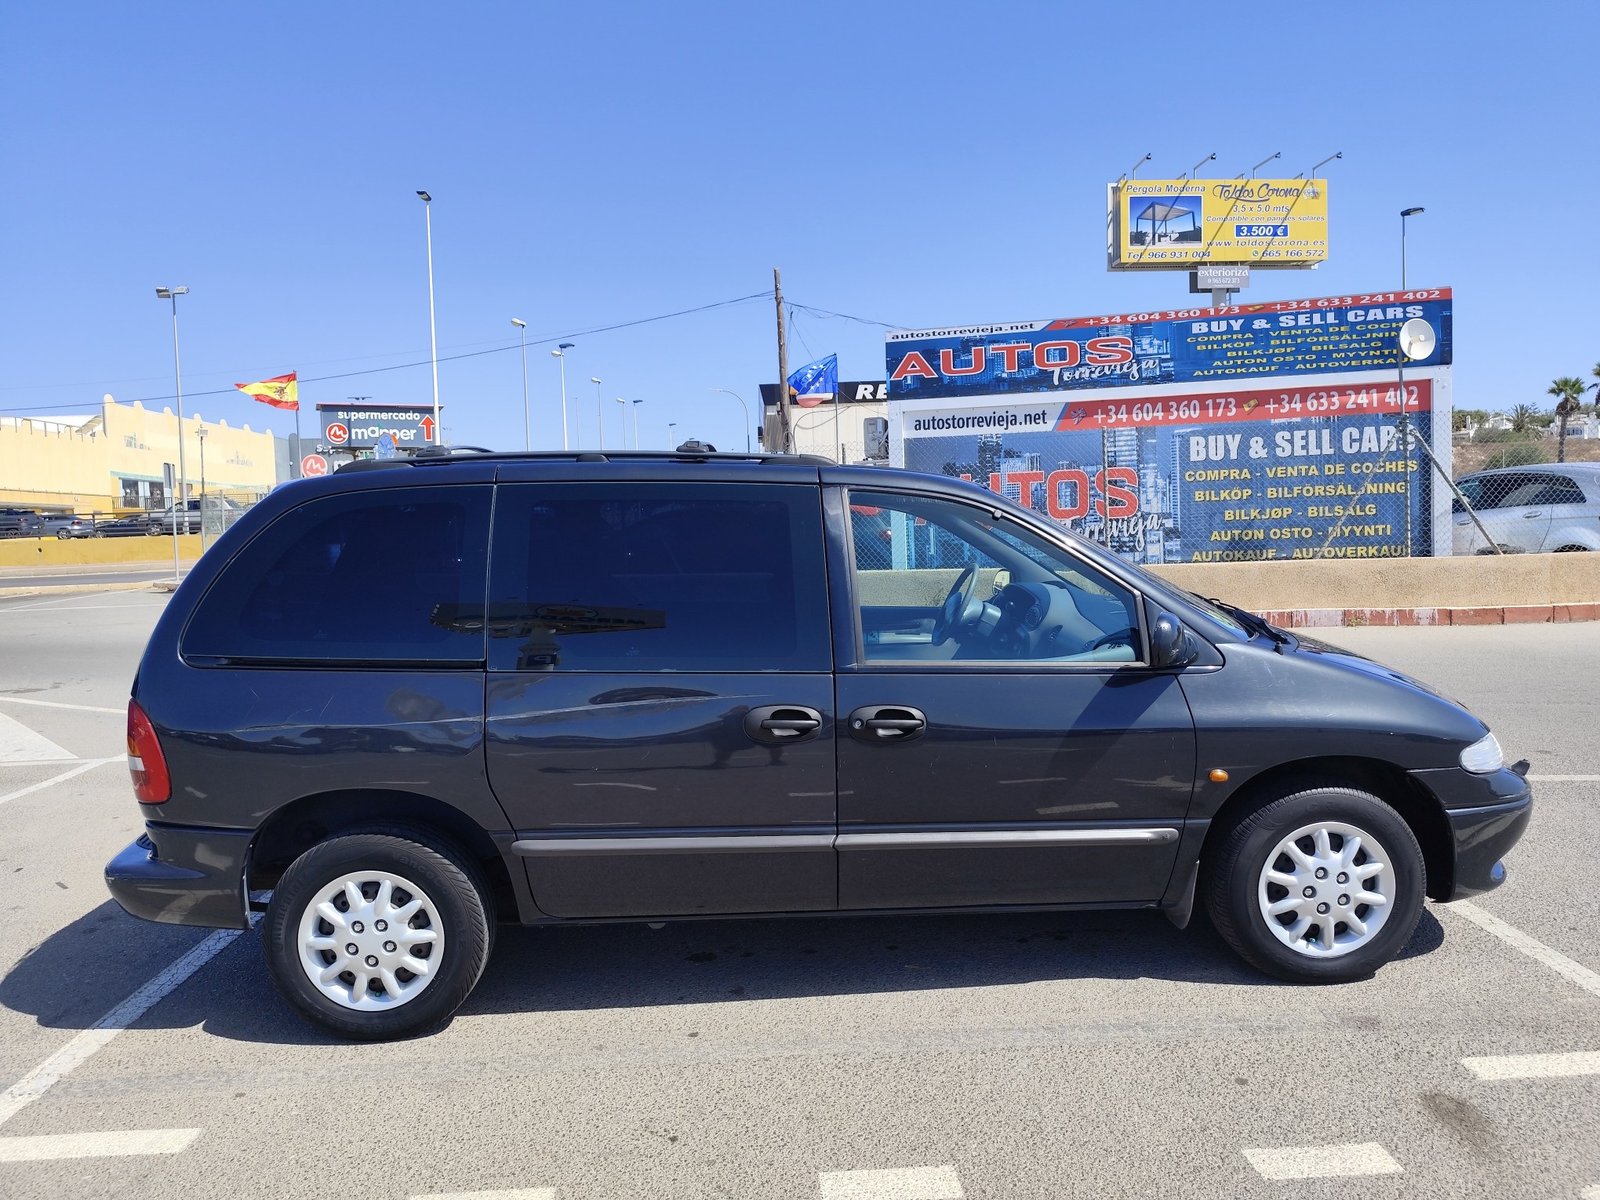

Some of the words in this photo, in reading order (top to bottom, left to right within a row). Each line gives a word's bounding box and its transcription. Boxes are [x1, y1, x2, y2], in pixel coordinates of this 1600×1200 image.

[1126, 185, 1162, 194] Pergola
[1212, 184, 1255, 201] Toldos
[1257, 183, 1300, 198] Corona
[1240, 226, 1273, 236] 3.500
[1276, 226, 1285, 236] €
[1148, 251, 1167, 259] 966
[1170, 251, 1188, 259] 931
[1192, 250, 1211, 259] 004
[1305, 249, 1325, 257] 572
[1198, 267, 1249, 277] exterioriza
[1271, 300, 1312, 311] +34
[1317, 297, 1353, 307] 633
[1359, 293, 1395, 304] 241
[1402, 290, 1441, 300] 402
[1085, 316, 1122, 326] +34
[1126, 312, 1162, 323] 604
[1167, 308, 1201, 319] 360
[1207, 306, 1240, 316] 173
[1191, 319, 1245, 334] BUY
[1252, 319, 1271, 330] &
[1279, 311, 1339, 328] SELL
[1347, 305, 1424, 322] CARS
[891, 322, 1035, 340] autostorrevieja.net
[1187, 333, 1254, 343] COMPRA
[1269, 328, 1323, 337] VENTA
[1355, 322, 1404, 331] COCH
[1196, 341, 1255, 351] BILKÖP
[1270, 331, 1398, 346] BILFÖRSÄLJNIN
[1226, 347, 1296, 357] BILKJØP
[1312, 341, 1382, 351] BILSALG
[890, 336, 1135, 381] AUTOS
[1212, 358, 1267, 367] AUTON
[1273, 354, 1317, 363] OSTO
[1332, 349, 1398, 359] MYYNTI
[1047, 357, 1160, 386] Torrevieja
[1193, 366, 1280, 377] AUTOKAUF
[1264, 393, 1302, 414] +34
[1306, 391, 1340, 411] 633
[1346, 388, 1378, 409] 241
[1385, 385, 1419, 407] 402
[337, 411, 421, 422] supermercado
[1093, 404, 1128, 424] +34
[1132, 402, 1164, 421] 604
[1168, 400, 1200, 420] 360
[1205, 397, 1237, 418] 173
[914, 409, 1048, 432] autostorrevieja.net
[1189, 434, 1242, 461] BUY
[1248, 436, 1268, 459] &
[1275, 429, 1335, 458] SELL
[1184, 468, 1252, 482] COMPRA
[1265, 465, 1319, 478] VENTA
[1324, 463, 1345, 476] DE
[1194, 486, 1252, 502] BILKÖP
[1224, 507, 1293, 521] BILKJØP
[1210, 529, 1265, 541] AUTON
[1269, 527, 1313, 539] OSTO
[1191, 548, 1277, 562] AUTOKAUF
